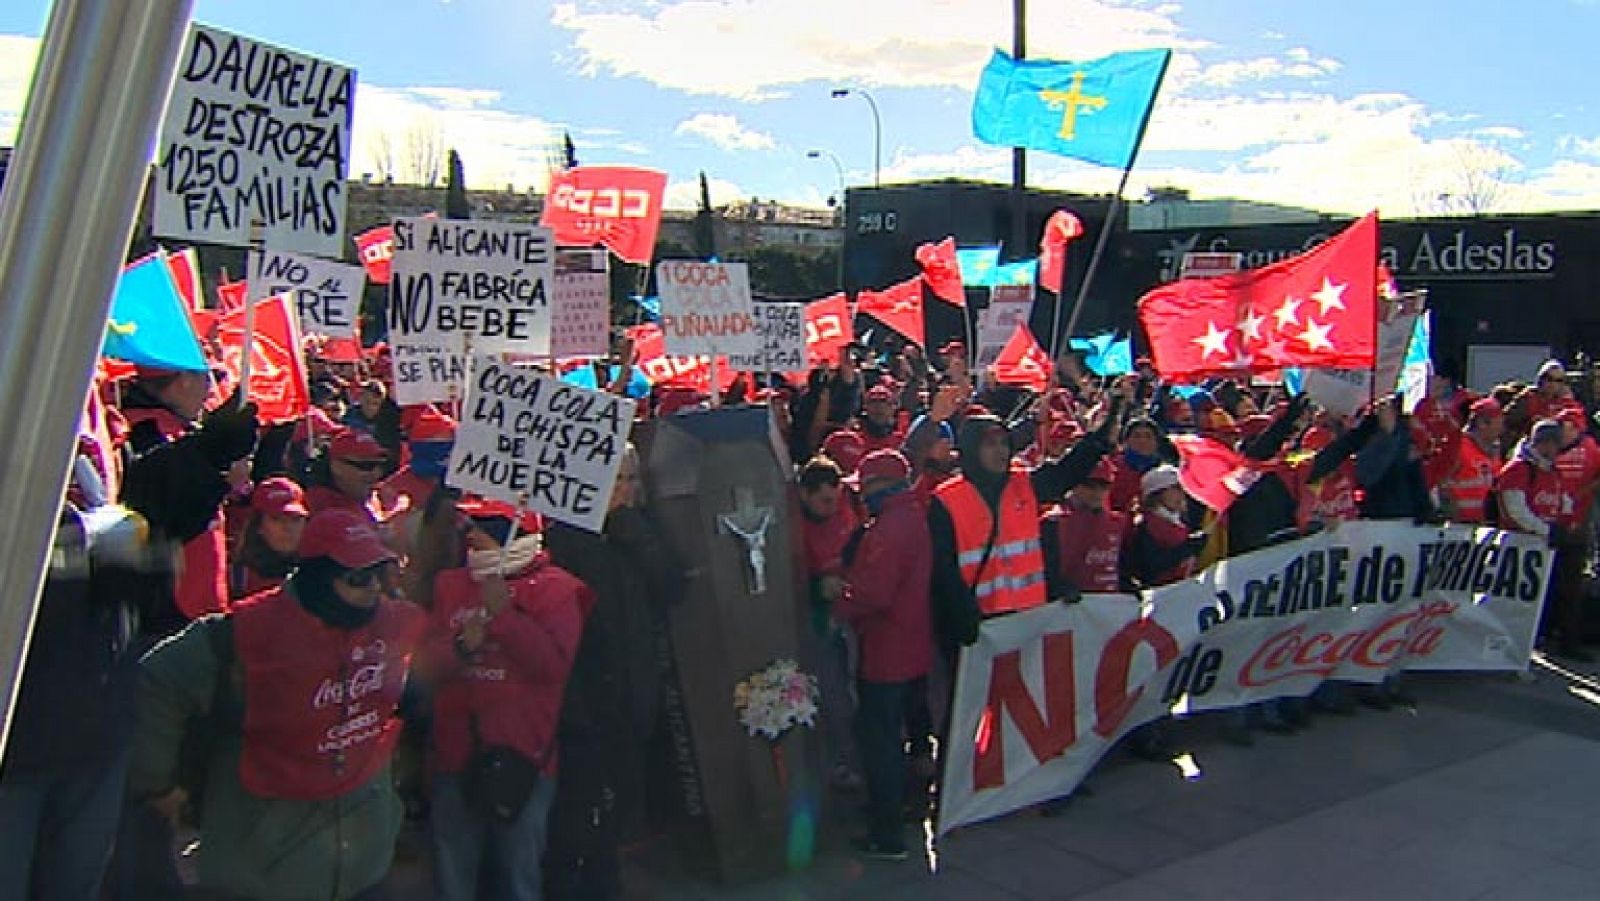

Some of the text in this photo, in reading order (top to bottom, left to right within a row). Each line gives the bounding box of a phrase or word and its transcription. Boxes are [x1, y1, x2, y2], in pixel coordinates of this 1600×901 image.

[183, 30, 350, 118] DAURELLA
[183, 97, 344, 181] DESTROZA
[161, 143, 240, 195] 1250
[674, 262, 731, 287] COCA
[1411, 230, 1555, 272] Adeslas
[270, 285, 349, 326] RE
[392, 272, 432, 335] NO
[437, 305, 535, 340] BEBE
[398, 361, 423, 383] SE
[473, 398, 505, 429] LA
[478, 363, 624, 434] COCA COLA
[497, 432, 566, 473] DE LA
[455, 452, 599, 514] MUERTE
[1352, 547, 1404, 604] de
[972, 615, 1224, 793] NO de
